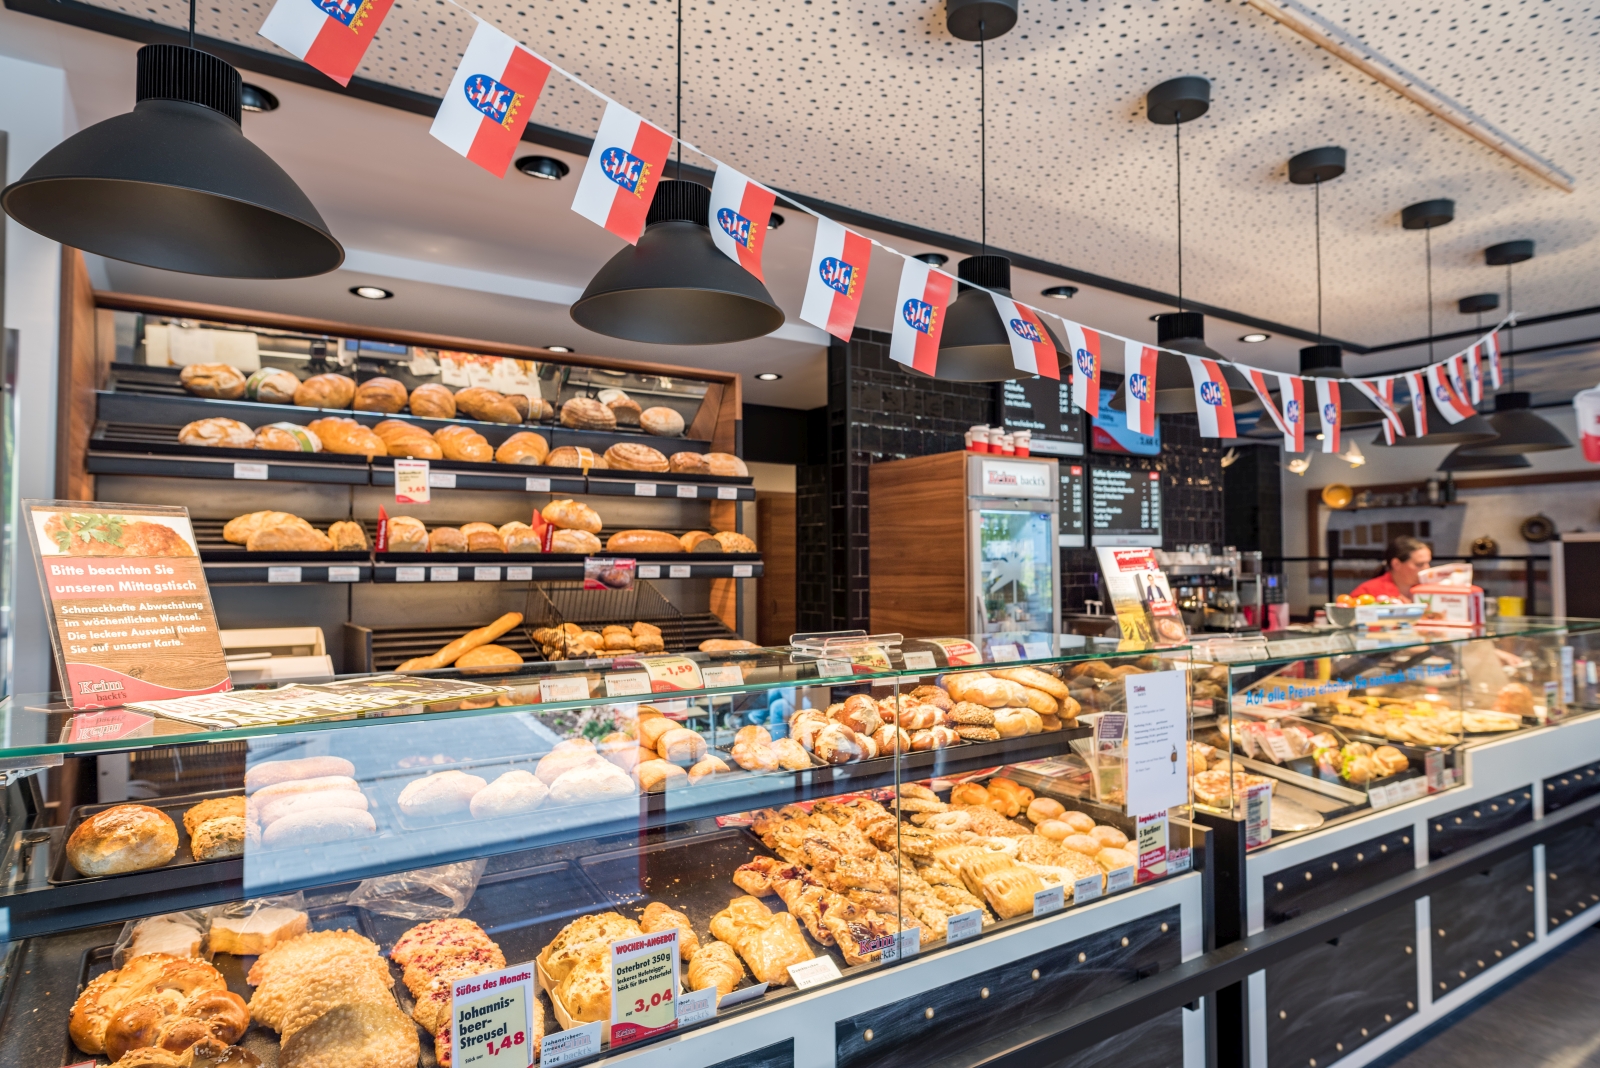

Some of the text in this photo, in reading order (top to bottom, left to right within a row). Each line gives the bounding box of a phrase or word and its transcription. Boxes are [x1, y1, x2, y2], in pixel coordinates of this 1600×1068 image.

[988, 470, 1018, 486] Keim
[1020, 475, 1046, 486] backt's
[50, 564, 174, 576] Bitte beachten Sie
[55, 580, 197, 594] unseren Mittagstisch
[61, 601, 204, 614] Schmackhafte Abwechslung
[64, 613, 202, 628] im wöchentlichen Wechsel.
[67, 625, 207, 641] Die leckere Auswahl finden
[70, 639, 184, 655] Sie auf unserer Karte.
[667, 664, 693, 676] 1,59
[78, 680, 125, 695] Keim
[1246, 688, 1265, 706] Auf
[1267, 686, 1286, 702] alle
[1288, 683, 1317, 699] Preise
[1318, 677, 1353, 695] erhalten
[1354, 674, 1368, 690] Sie
[96, 691, 128, 702] backt's
[1143, 825, 1162, 837] Berliner
[615, 932, 676, 955] WOCHEN-ANGEBOT
[858, 934, 896, 956] Keim
[870, 947, 896, 962] backt's
[616, 959, 650, 976] Osterbrot
[648, 968, 672, 982] Ostertafel
[455, 972, 532, 997] Süßes des Monats:
[616, 974, 638, 985] leckeres
[634, 988, 673, 1013] 3,04
[458, 996, 515, 1023] Johannis-
[459, 1019, 492, 1036] beer-
[460, 1022, 508, 1050] Streusel
[486, 1031, 525, 1056] 1,48
[544, 1032, 584, 1047] Johannisbeer-
[544, 1042, 566, 1053] streusel
[563, 1046, 592, 1061] backt's
[464, 1055, 476, 1064] Stück
